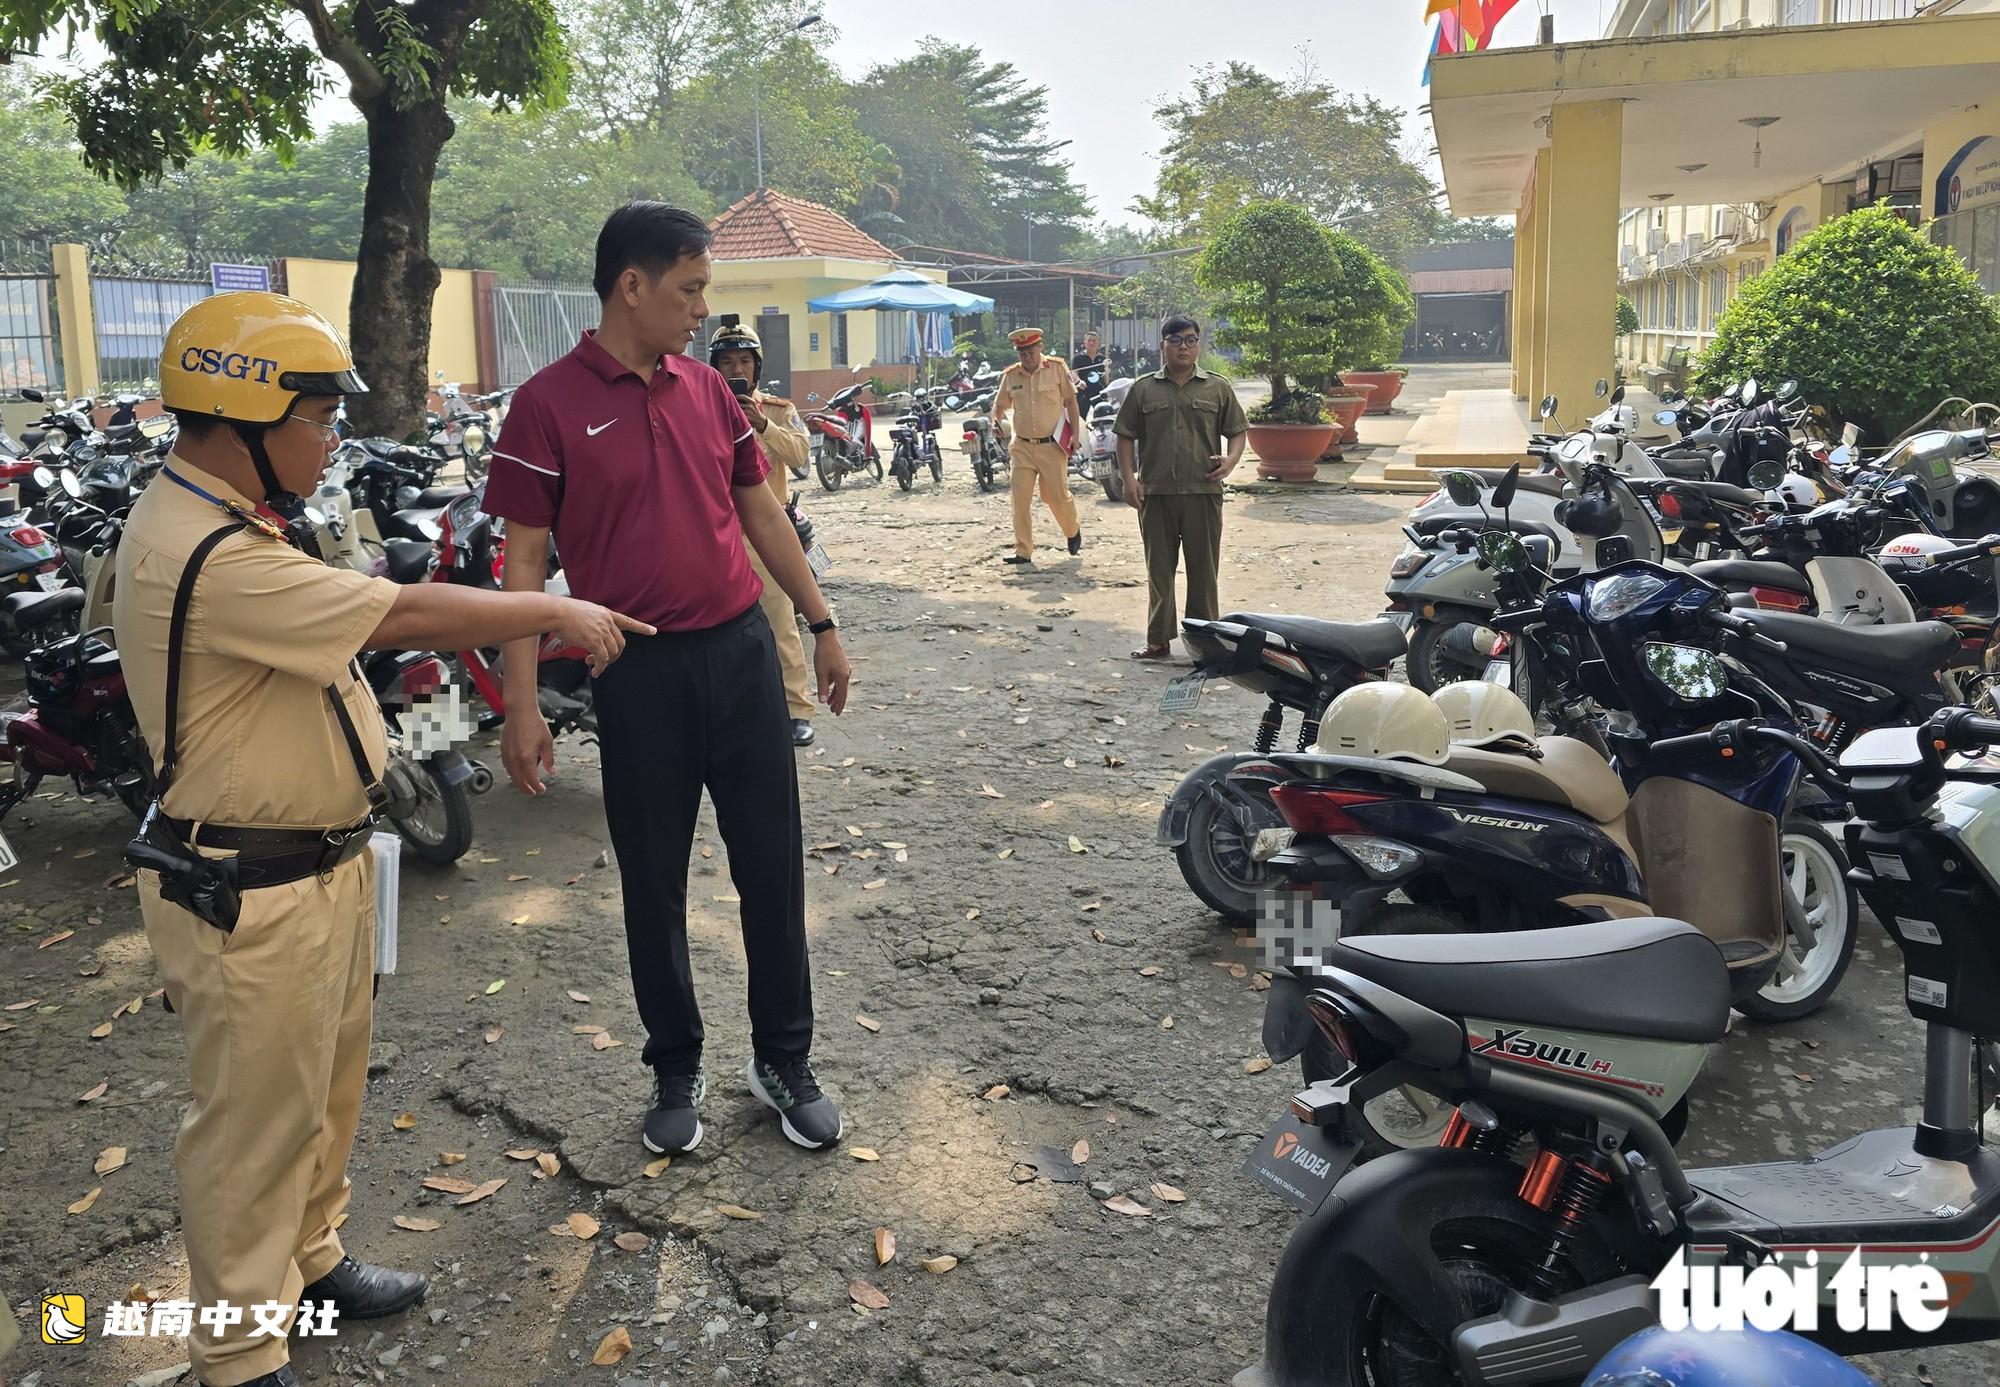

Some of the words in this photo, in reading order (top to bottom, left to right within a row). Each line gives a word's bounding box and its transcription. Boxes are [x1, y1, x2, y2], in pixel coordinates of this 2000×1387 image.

[181, 347, 278, 384] CSGT
[1437, 806, 1549, 832] VISION
[1471, 1027, 1591, 1070] XBULL
[1591, 1058, 1613, 1075] H
[1290, 1145, 1331, 1180] YADEA
